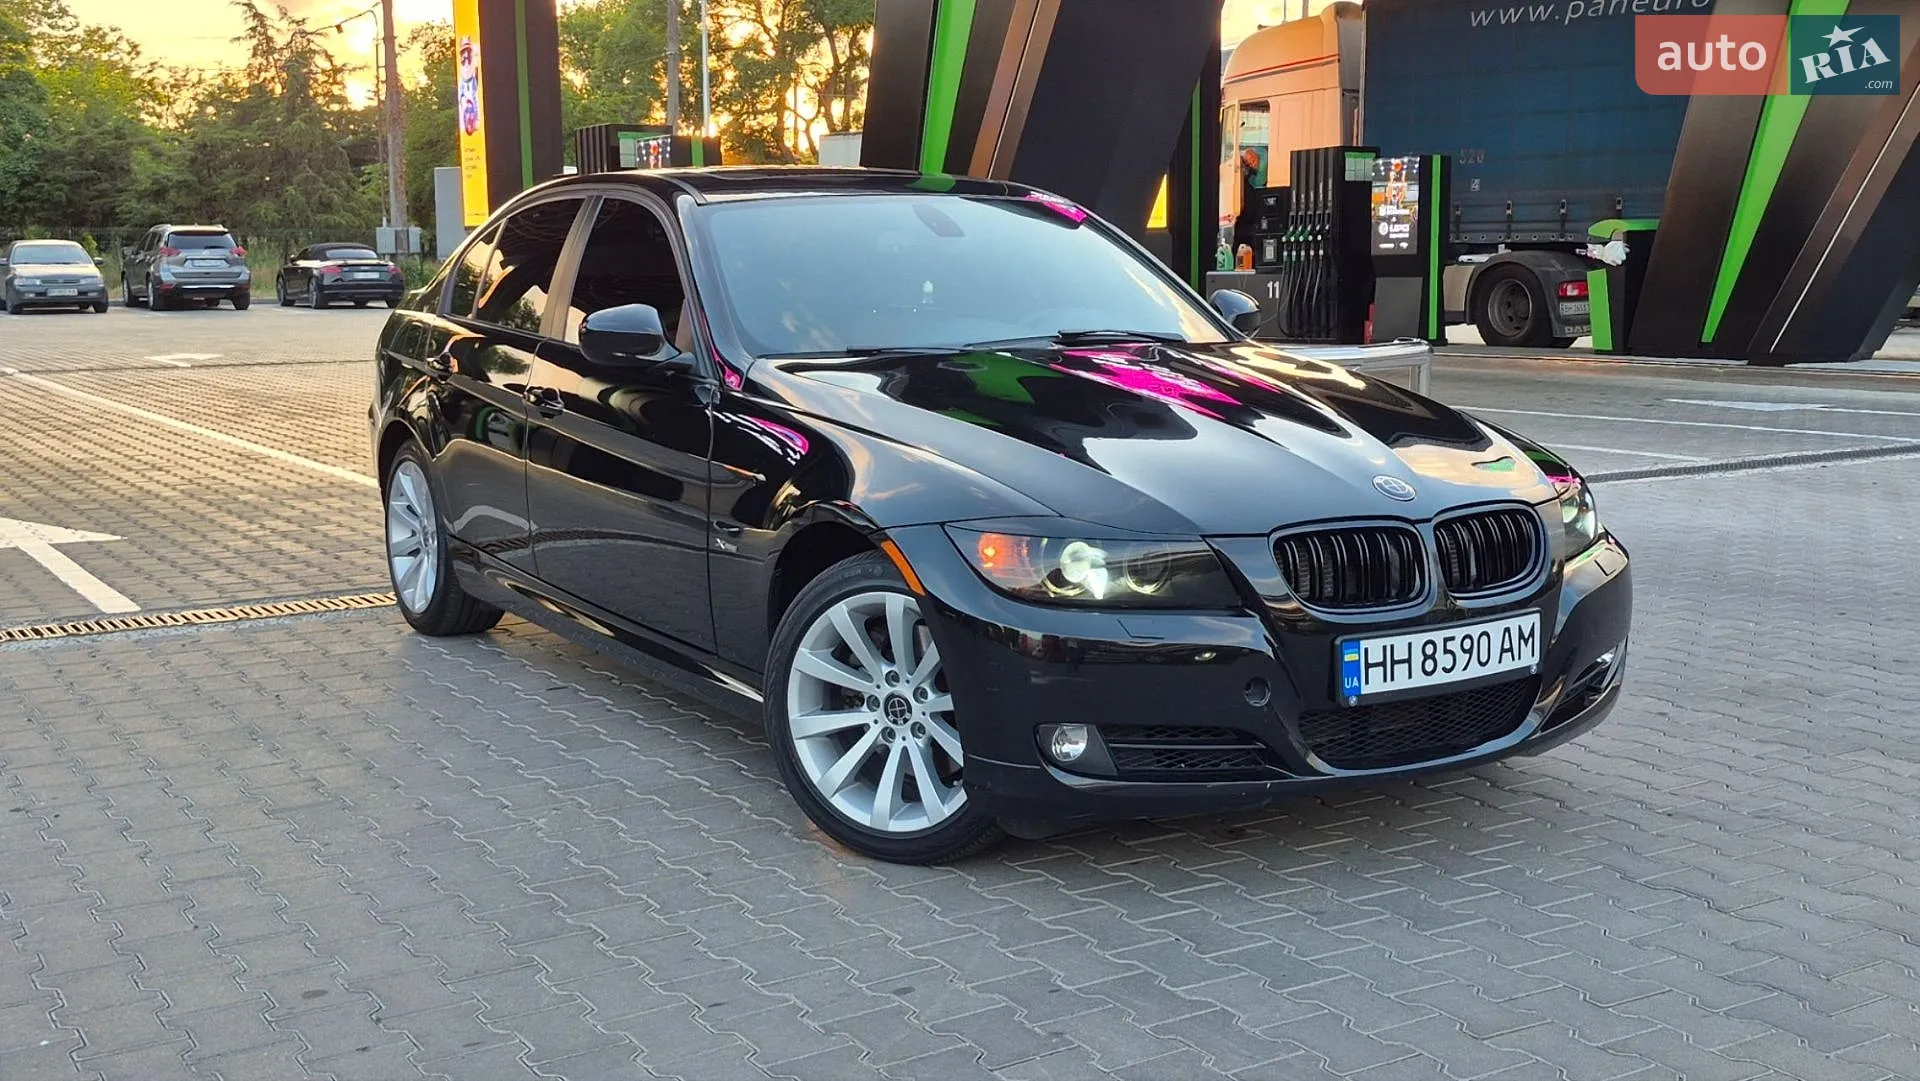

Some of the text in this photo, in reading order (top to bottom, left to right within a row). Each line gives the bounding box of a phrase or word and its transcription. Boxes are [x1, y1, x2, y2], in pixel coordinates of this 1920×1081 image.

[1266, 281, 1280, 299] 11
[1364, 622, 1536, 686] HH 8590 AM
[1344, 677, 1360, 689] UA
